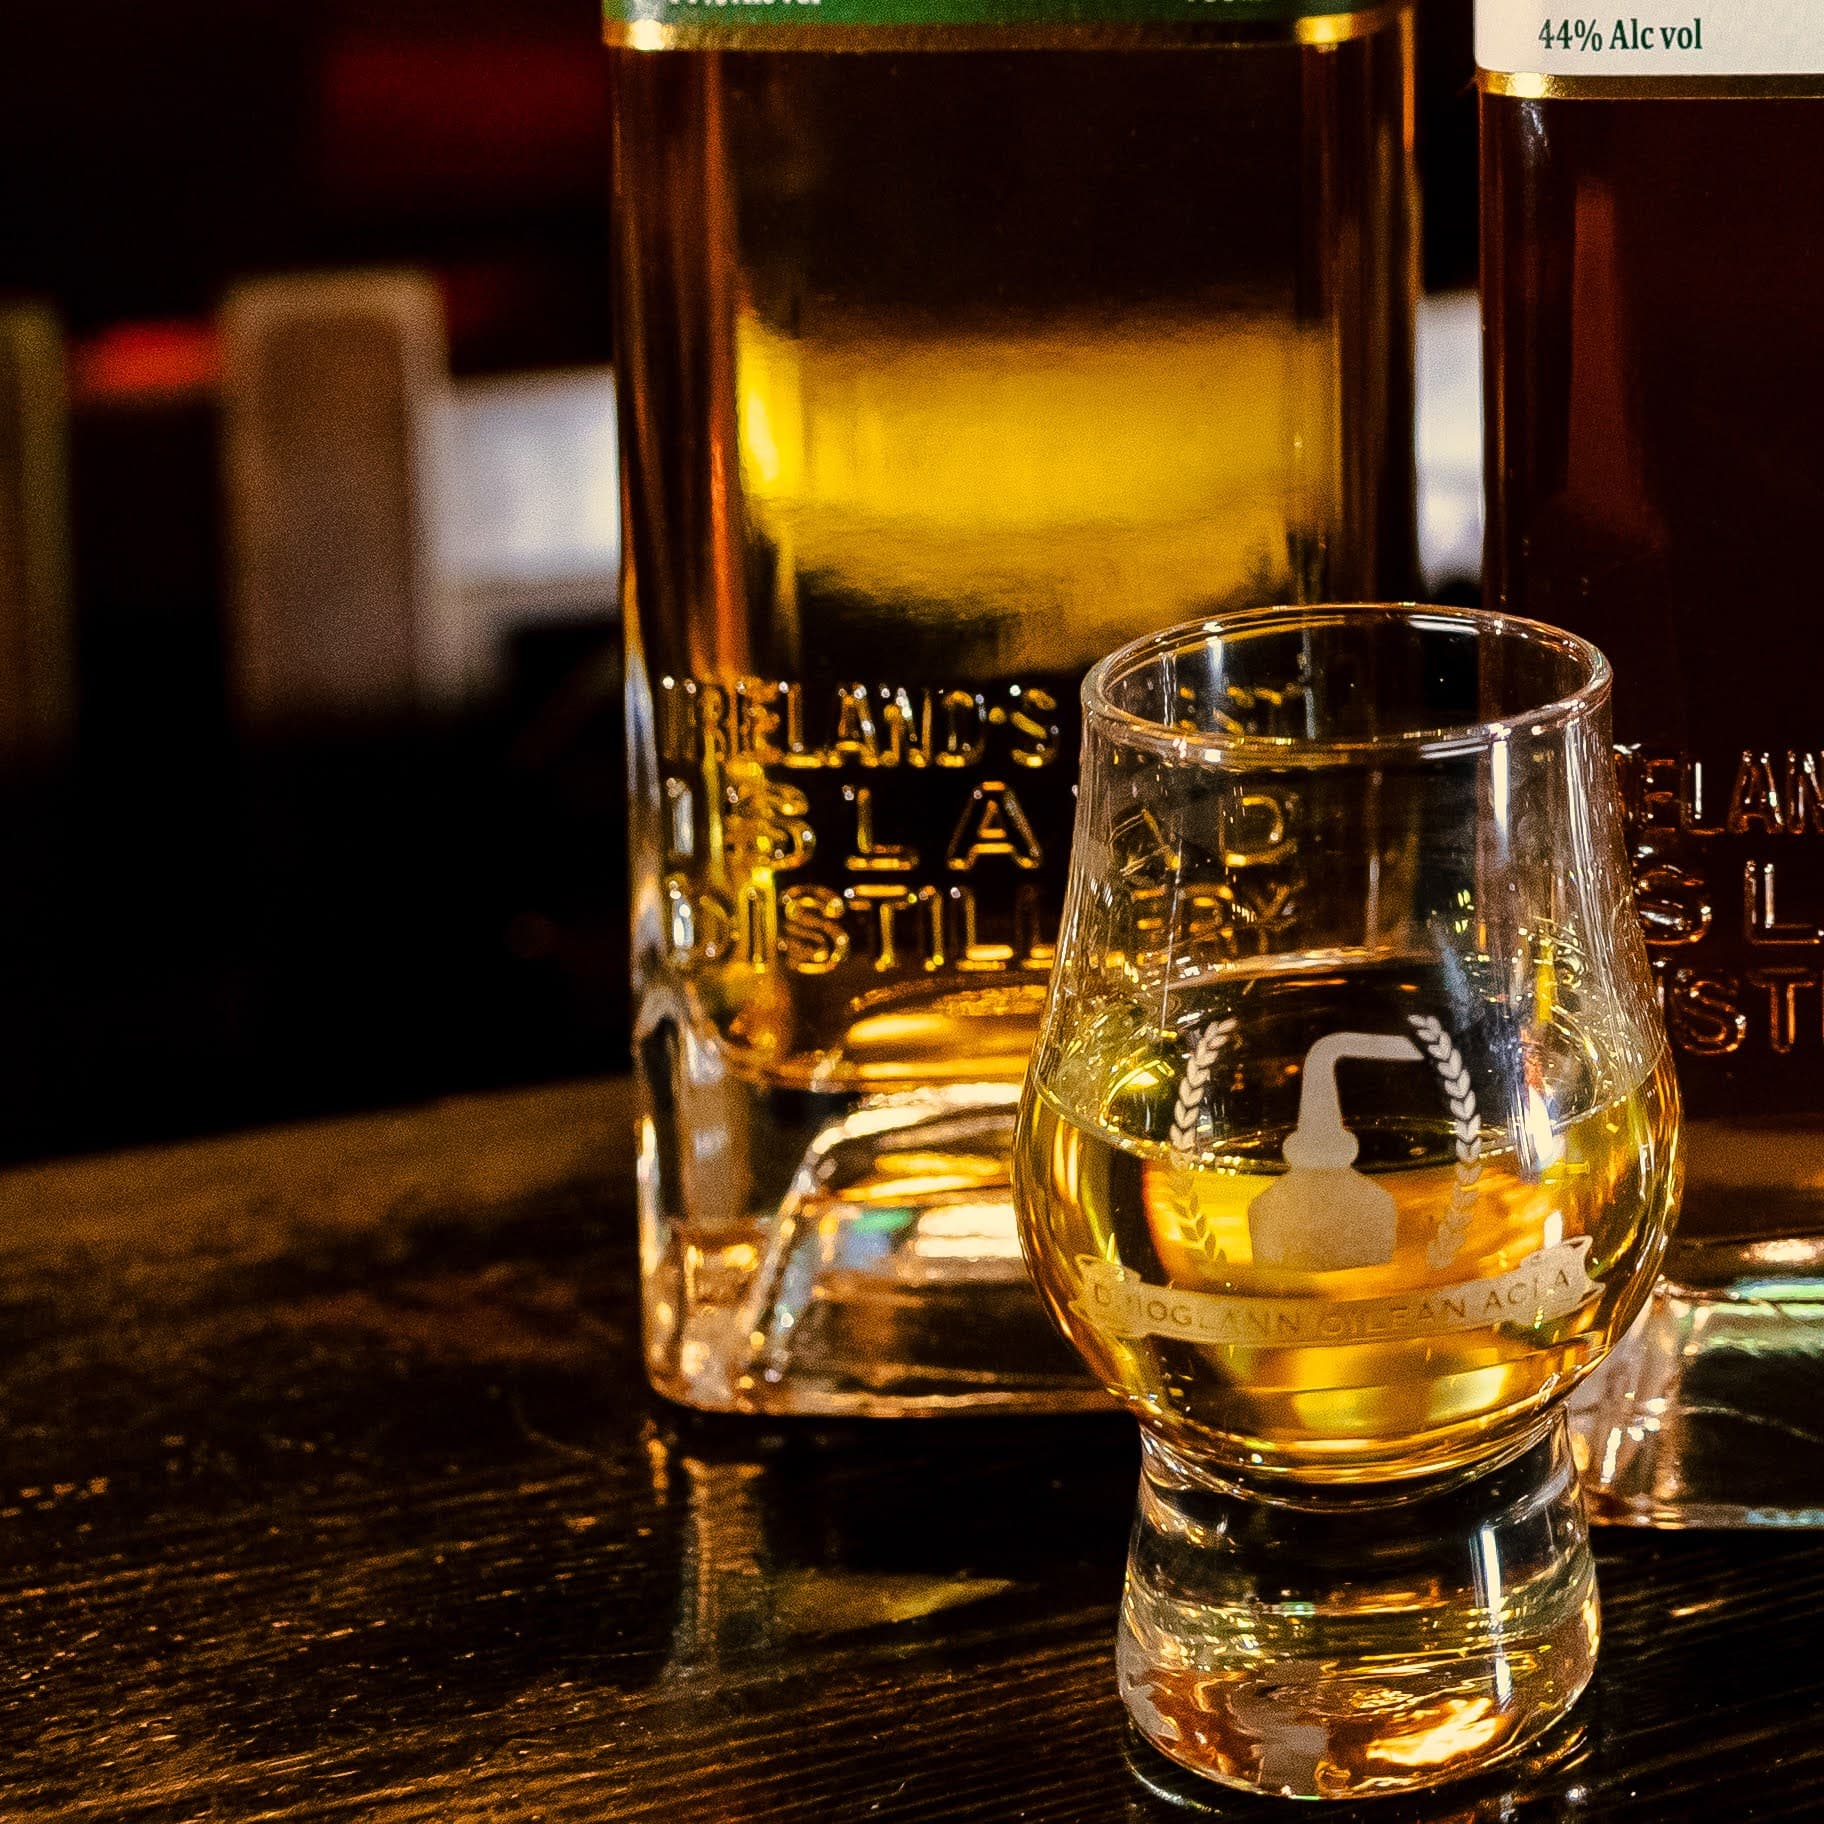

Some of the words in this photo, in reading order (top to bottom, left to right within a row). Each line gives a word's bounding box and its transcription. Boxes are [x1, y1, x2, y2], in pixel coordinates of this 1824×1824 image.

[1538, 18, 1603, 53] 44%
[1609, 18, 1655, 51] Alc
[1659, 18, 1703, 51] vol
